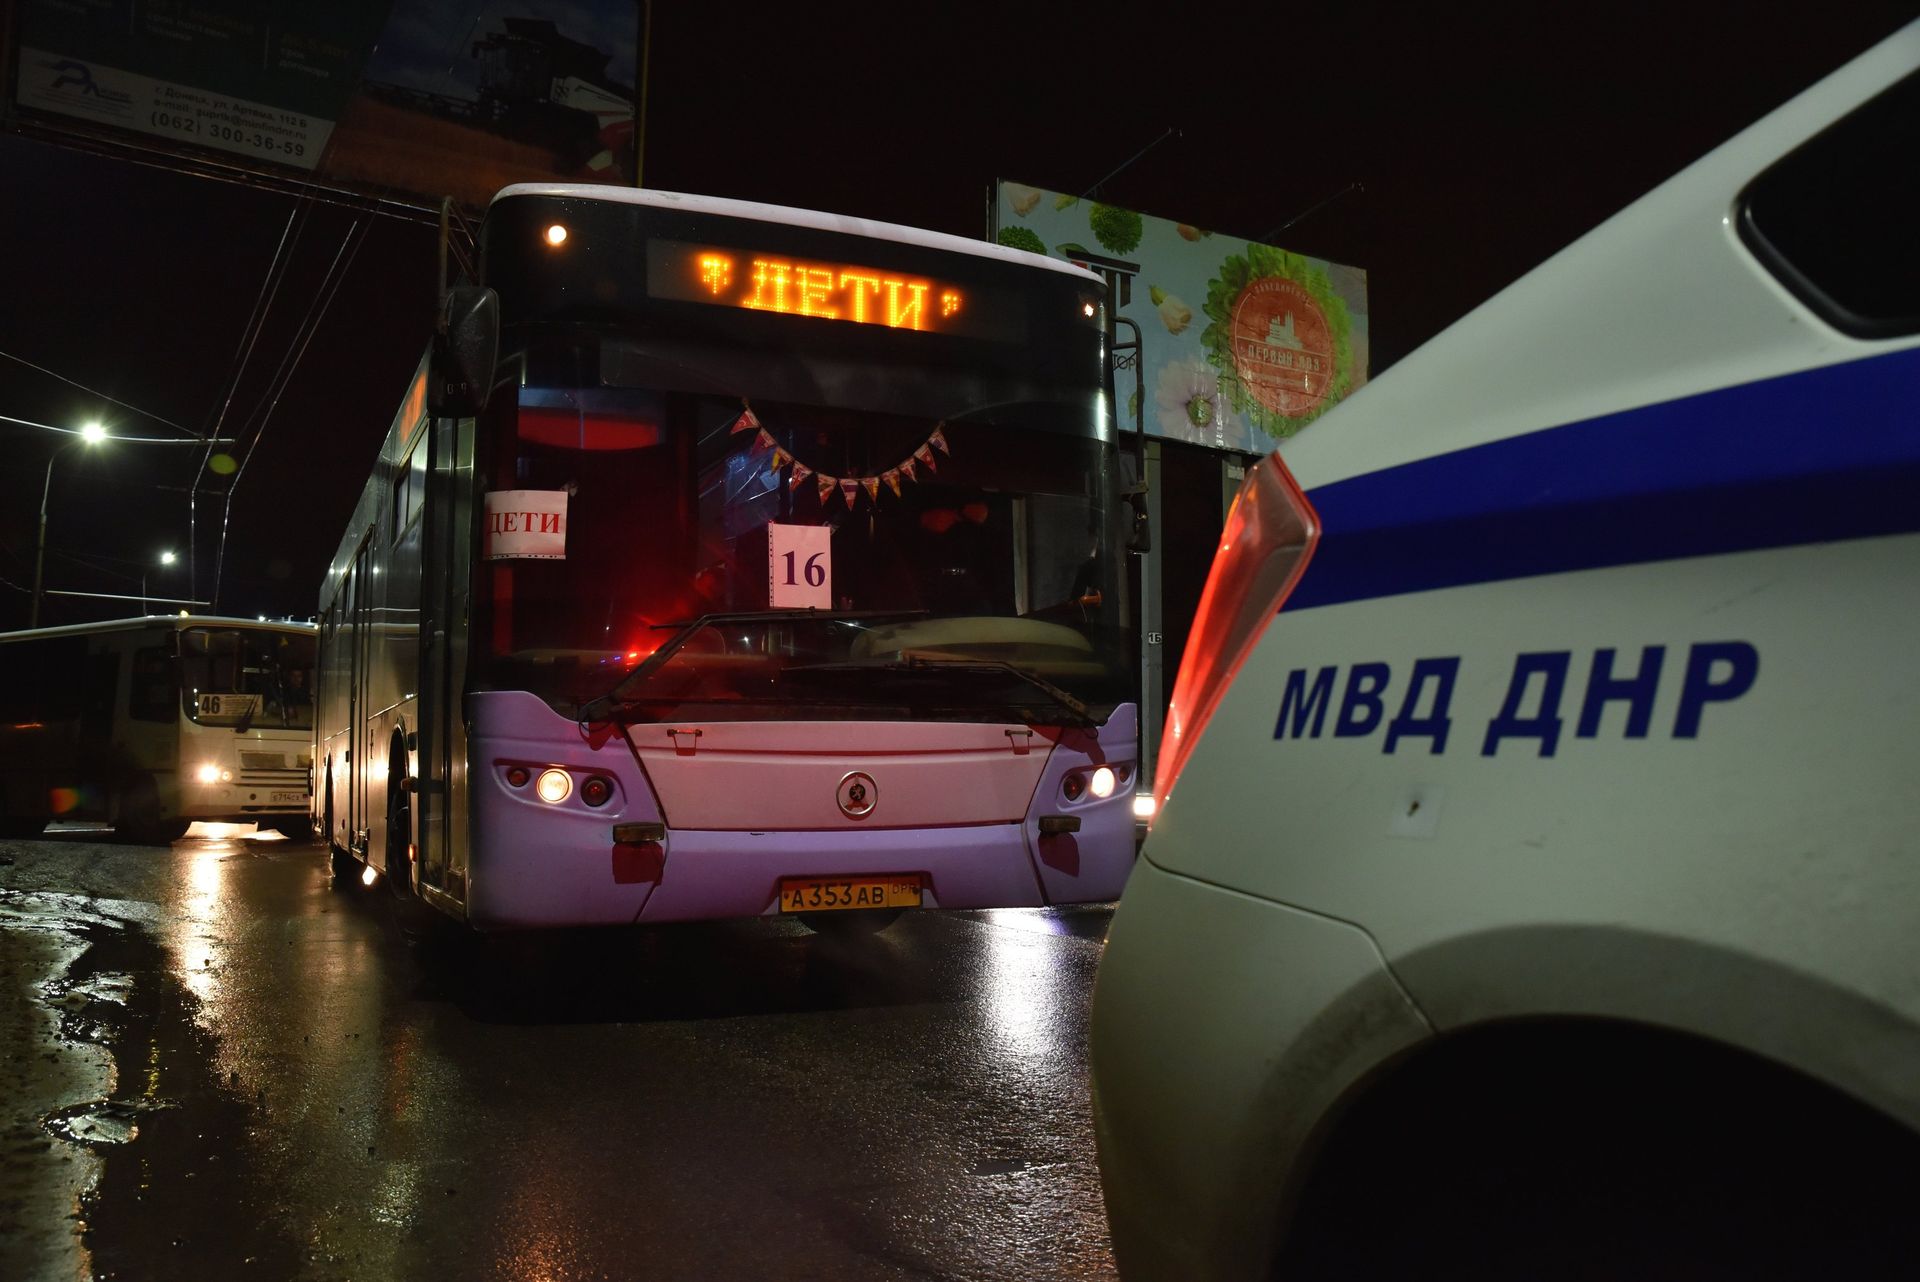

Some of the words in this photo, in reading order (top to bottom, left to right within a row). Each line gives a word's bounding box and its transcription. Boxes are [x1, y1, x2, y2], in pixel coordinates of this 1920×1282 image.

[151, 111, 201, 135] (062)
[209, 124, 305, 157] 300-36-59
[742, 259, 929, 331] ДЕТИ
[1248, 344, 1293, 367] ПЕРВЫЙ
[487, 512, 561, 536] ДЕТИ
[781, 550, 826, 587] 16
[201, 695, 220, 714] 46
[1274, 665, 1461, 755] МВД
[1480, 641, 1760, 758] ДНР
